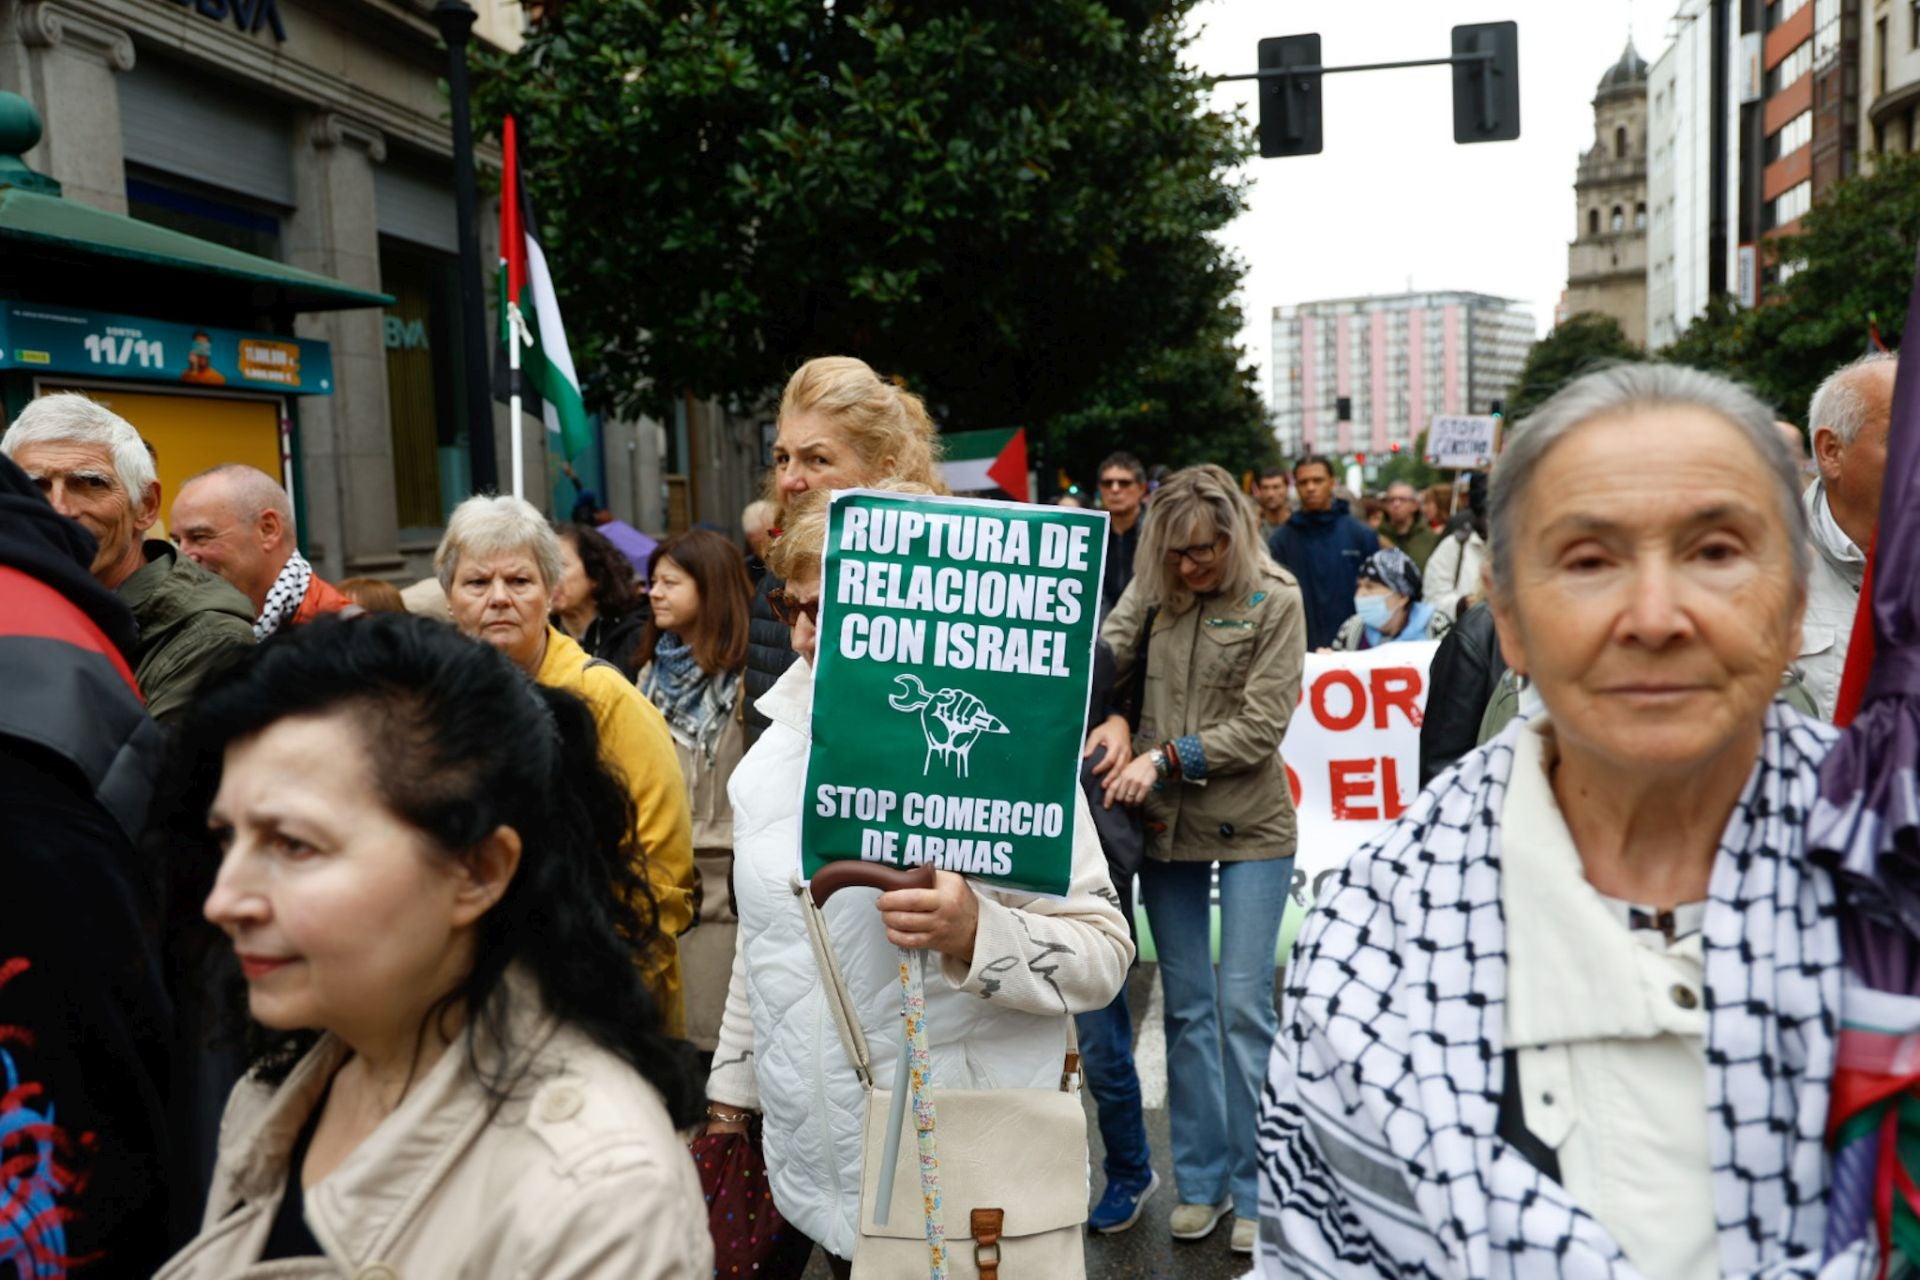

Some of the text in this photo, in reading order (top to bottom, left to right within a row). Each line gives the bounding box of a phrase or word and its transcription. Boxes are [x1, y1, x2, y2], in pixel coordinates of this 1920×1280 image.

[172, 0, 286, 42] VA
[84, 334, 163, 368] 11/11
[384, 316, 430, 350] BVA
[840, 507, 1091, 571] RUPTURA DE
[837, 559, 1083, 625] RELACIONES
[840, 613, 1070, 677] CON ISRAEL
[1298, 667, 1422, 732] OR
[816, 784, 1063, 838] STOP COMERCIO
[1328, 756, 1409, 820] EL
[861, 828, 1013, 875] DE ARMAS
